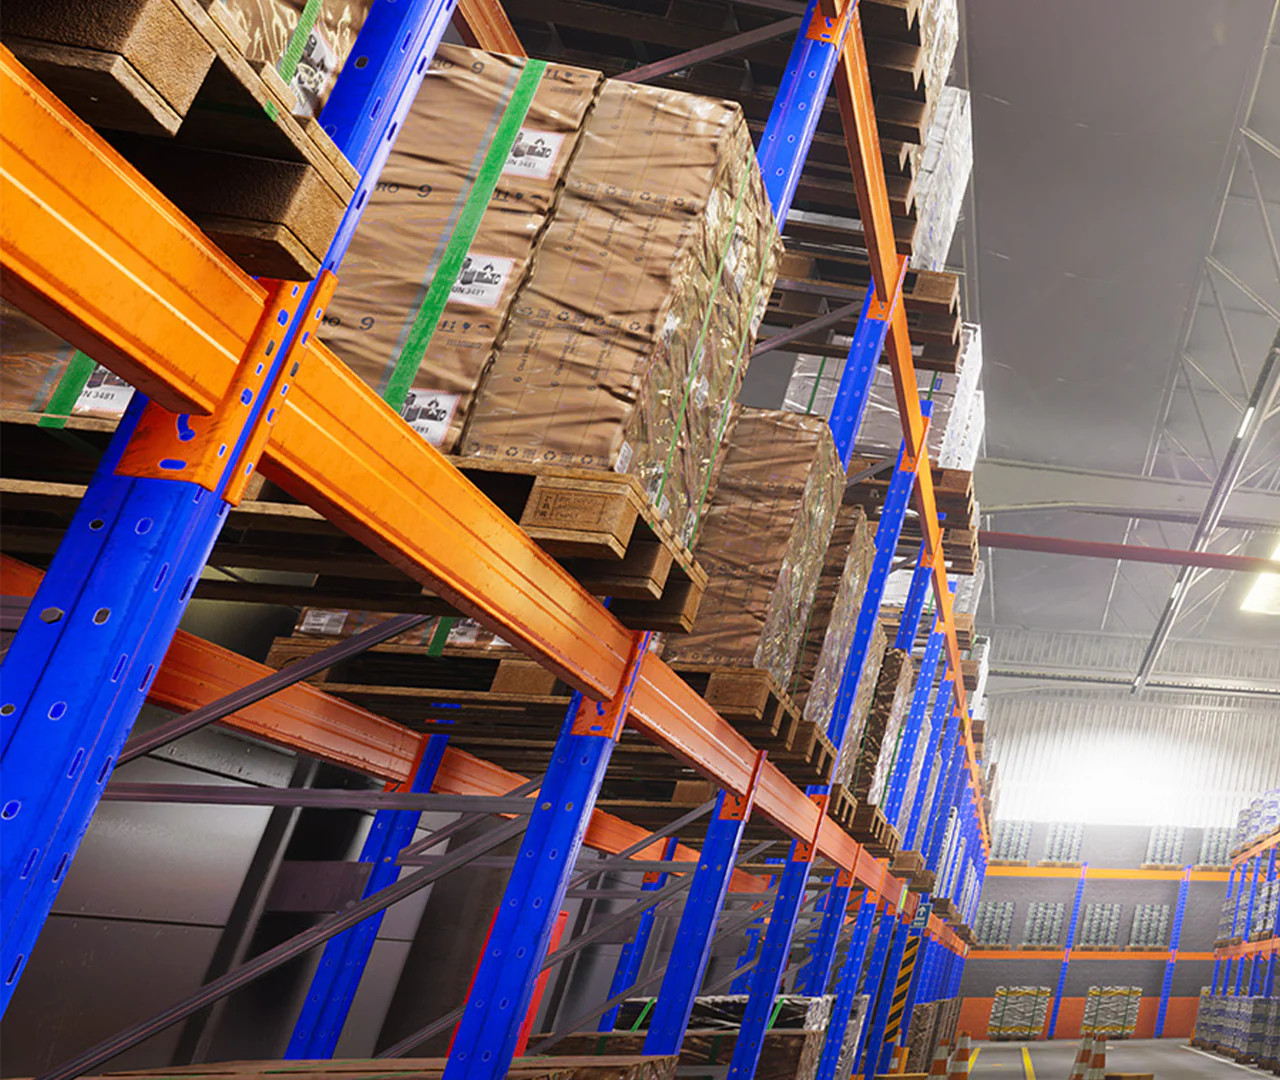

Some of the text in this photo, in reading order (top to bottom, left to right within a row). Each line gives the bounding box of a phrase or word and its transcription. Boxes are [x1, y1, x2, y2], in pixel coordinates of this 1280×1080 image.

[471, 61, 485, 74] 9
[417, 183, 432, 198] 9
[359, 315, 375, 331] 9
